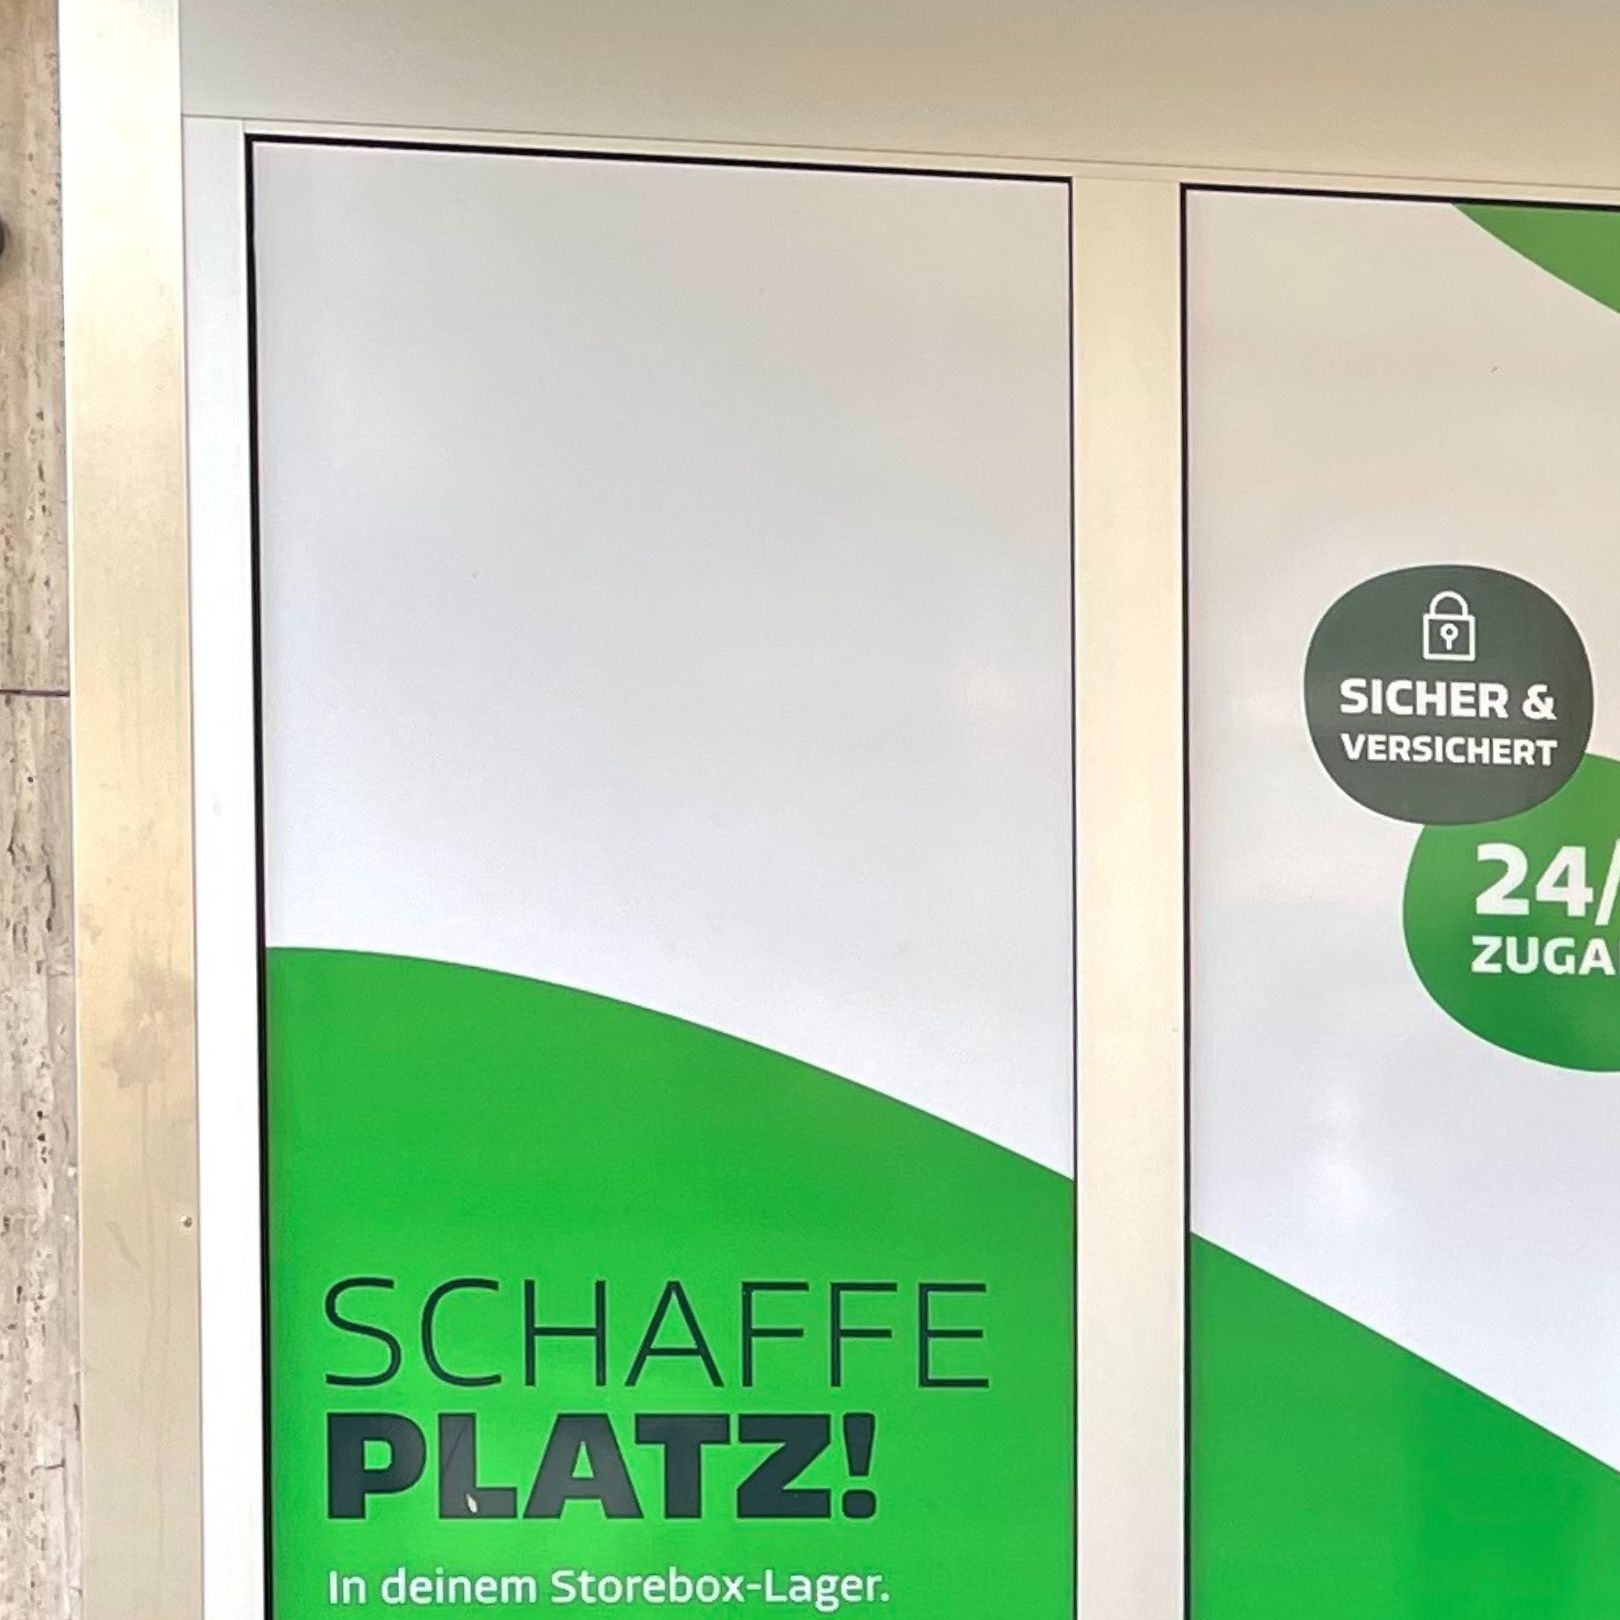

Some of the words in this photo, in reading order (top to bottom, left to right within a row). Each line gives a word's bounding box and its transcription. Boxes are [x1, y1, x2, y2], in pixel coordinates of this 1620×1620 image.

[1340, 677, 1510, 719] SICHER
[1522, 684, 1558, 720] &
[1340, 733, 1559, 766] VERSICHERT
[324, 1277, 991, 1388] SCHAFFE
[326, 1412, 877, 1520] PLATZ!
[329, 1570, 366, 1604] In
[381, 1567, 537, 1605] deinem
[551, 1566, 890, 1612] Storebox-Lager.
